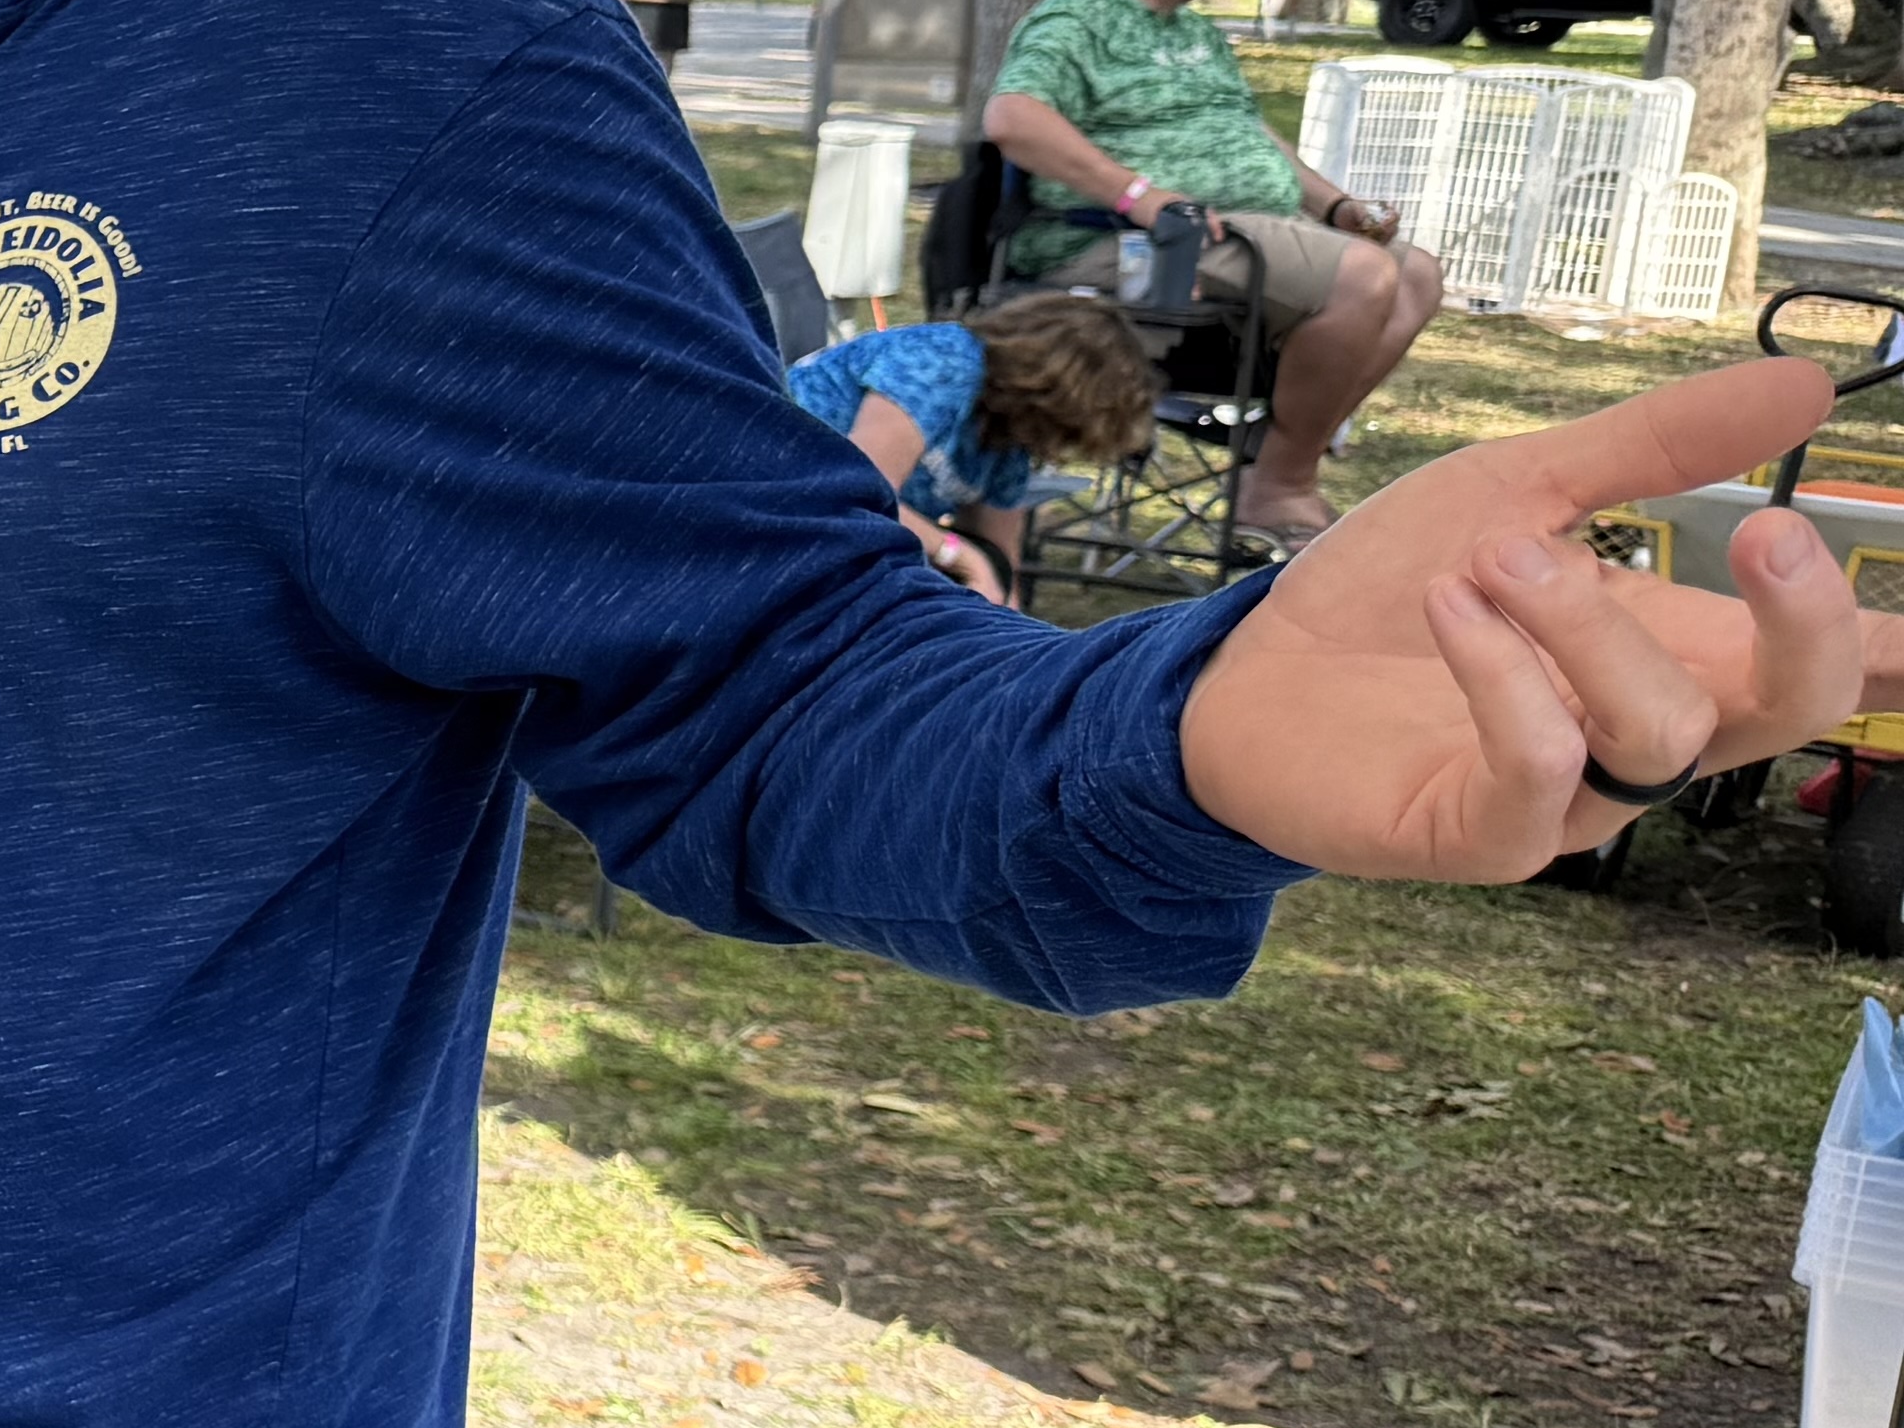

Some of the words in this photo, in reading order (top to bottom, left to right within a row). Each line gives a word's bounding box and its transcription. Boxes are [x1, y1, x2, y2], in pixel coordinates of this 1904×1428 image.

[26, 190, 78, 215] BEER
[79, 201, 101, 224] IS
[97, 214, 143, 278] GOOD!
[31, 359, 91, 402] CO.
[0, 434, 30, 455] FL
